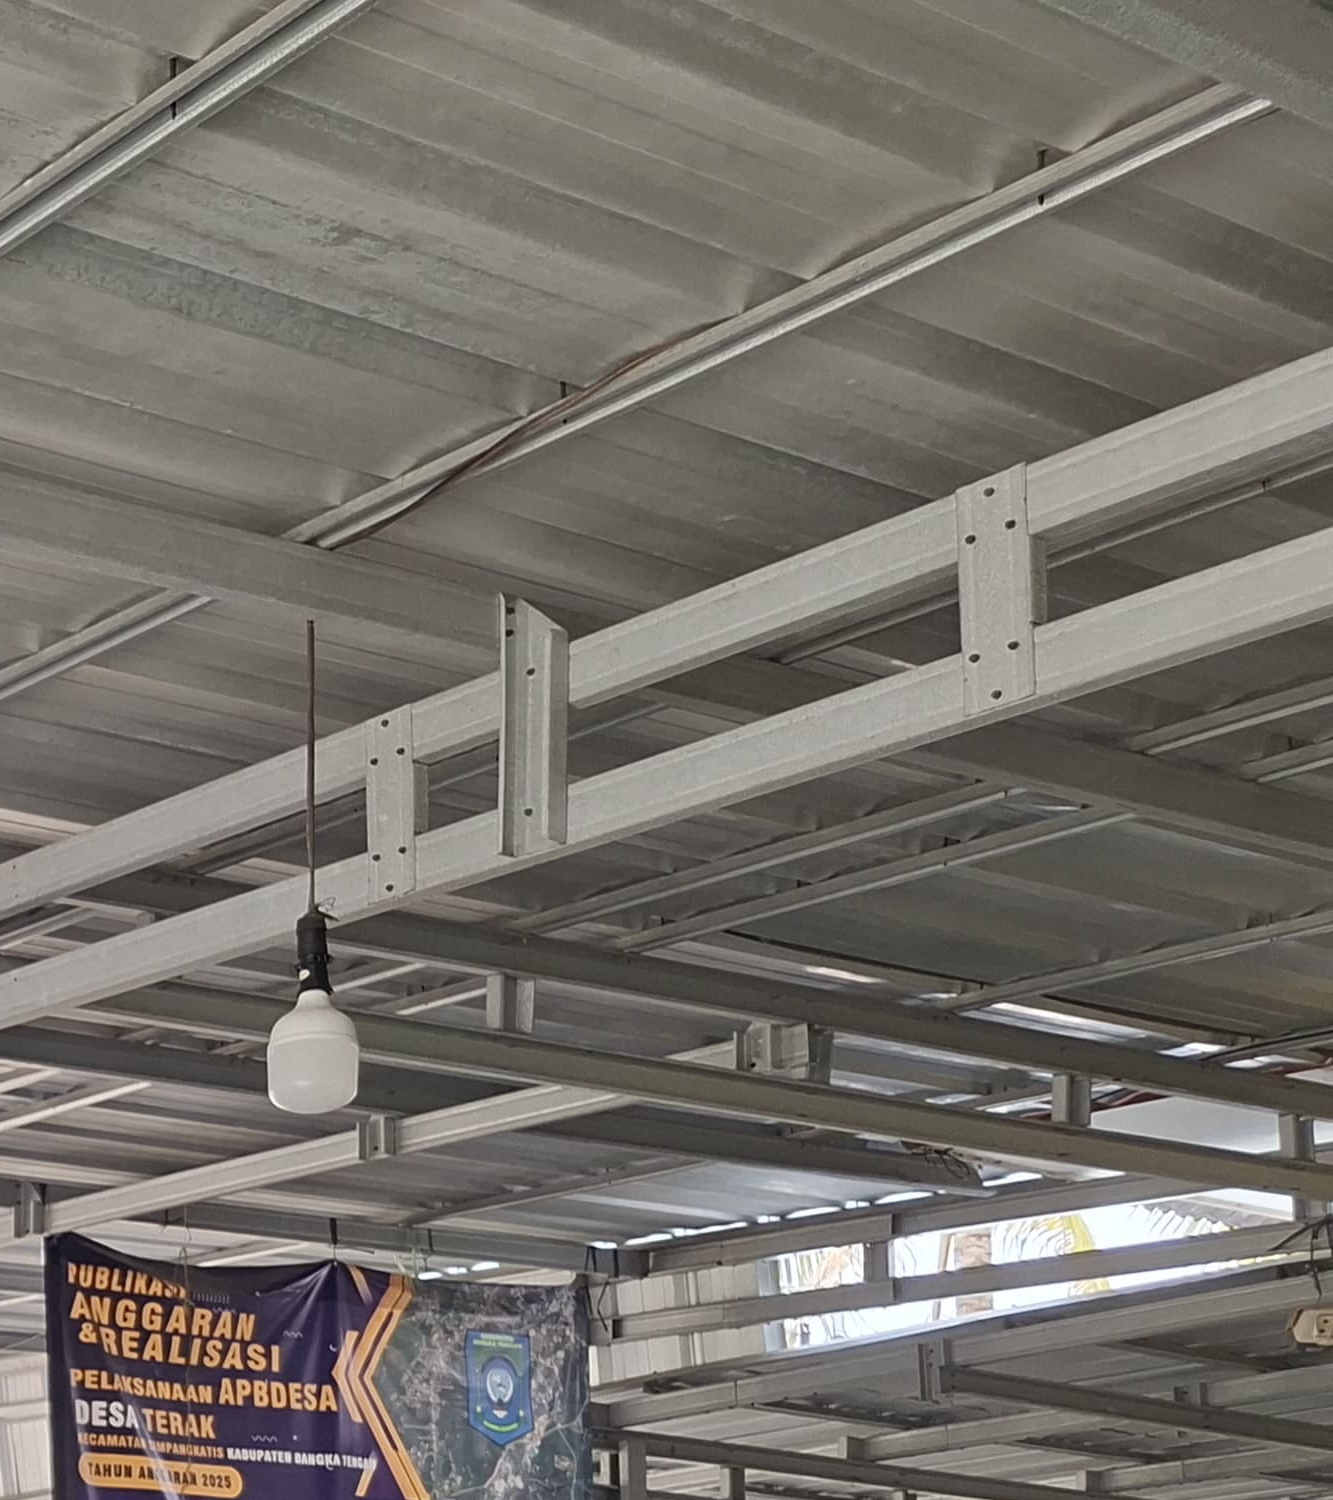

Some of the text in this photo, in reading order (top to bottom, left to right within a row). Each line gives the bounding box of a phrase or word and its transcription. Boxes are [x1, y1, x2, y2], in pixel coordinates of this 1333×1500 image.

[70, 1292, 257, 1341] ANGGARAN
[70, 1369, 338, 1411] PELAKSANAAN APBDESA
[74, 1399, 216, 1439] DESA TERAK
[88, 1461, 133, 1479] TAHUN
[202, 1472, 232, 1488] 2025
